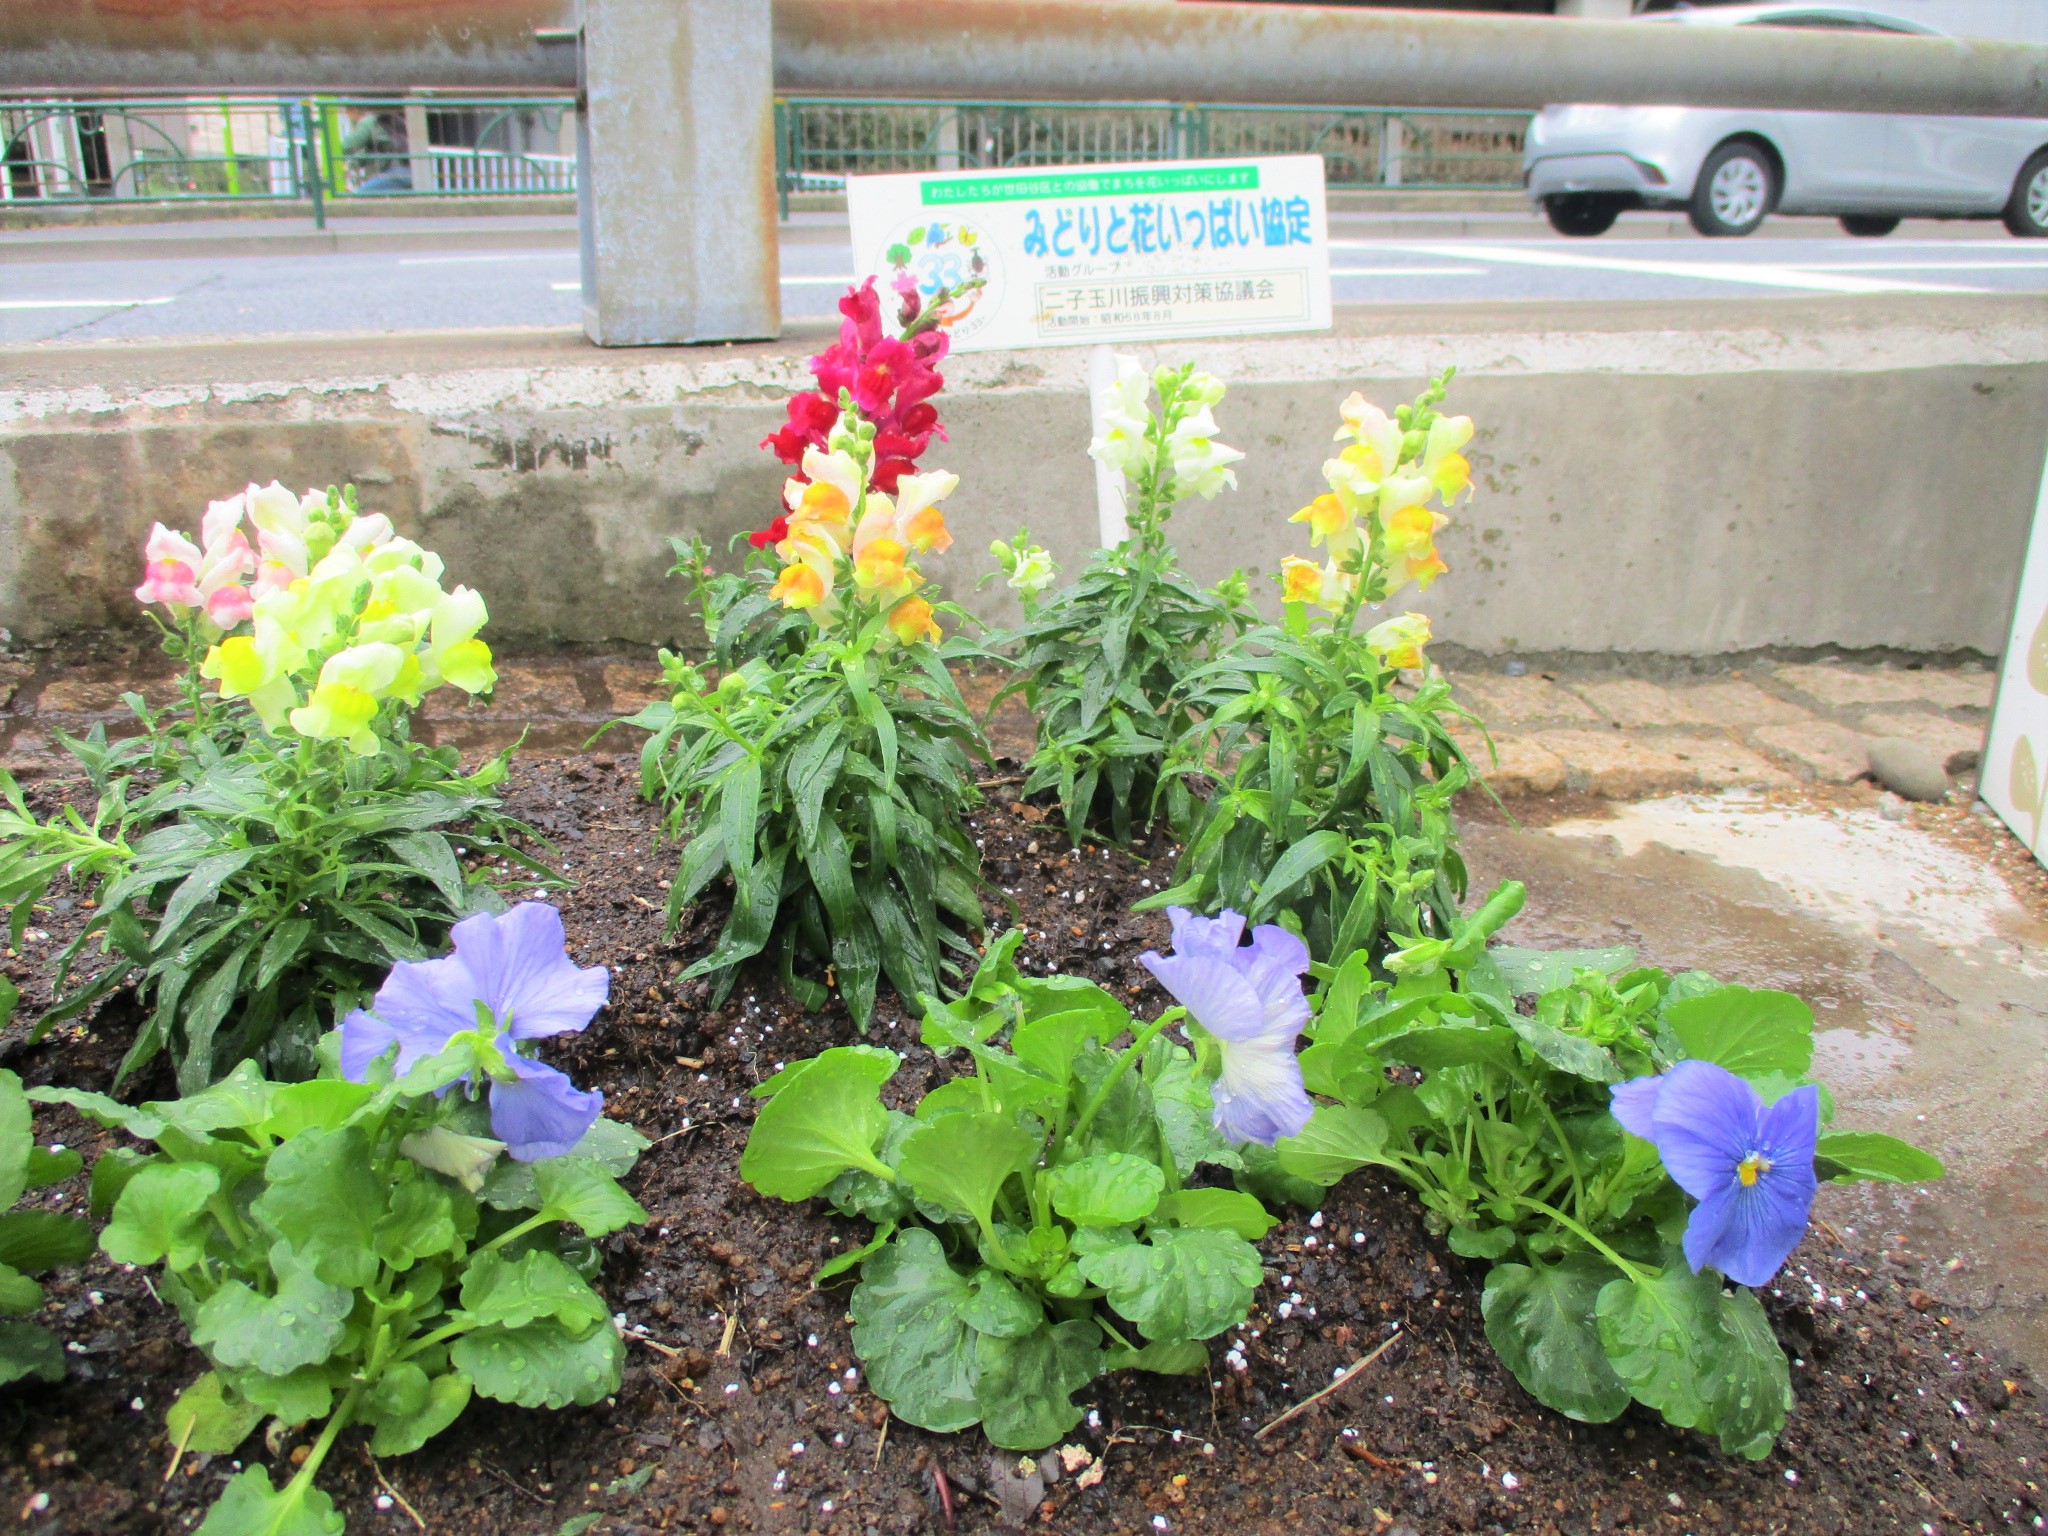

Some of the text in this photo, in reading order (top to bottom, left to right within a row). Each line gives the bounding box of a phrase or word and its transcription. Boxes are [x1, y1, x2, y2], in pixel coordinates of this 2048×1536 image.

[1023, 194, 1312, 257] みどりと花いっぱい協定
[1044, 261, 1121, 279] 活動グループ
[1045, 278, 1275, 311] 二子玉川振興対策協議会
